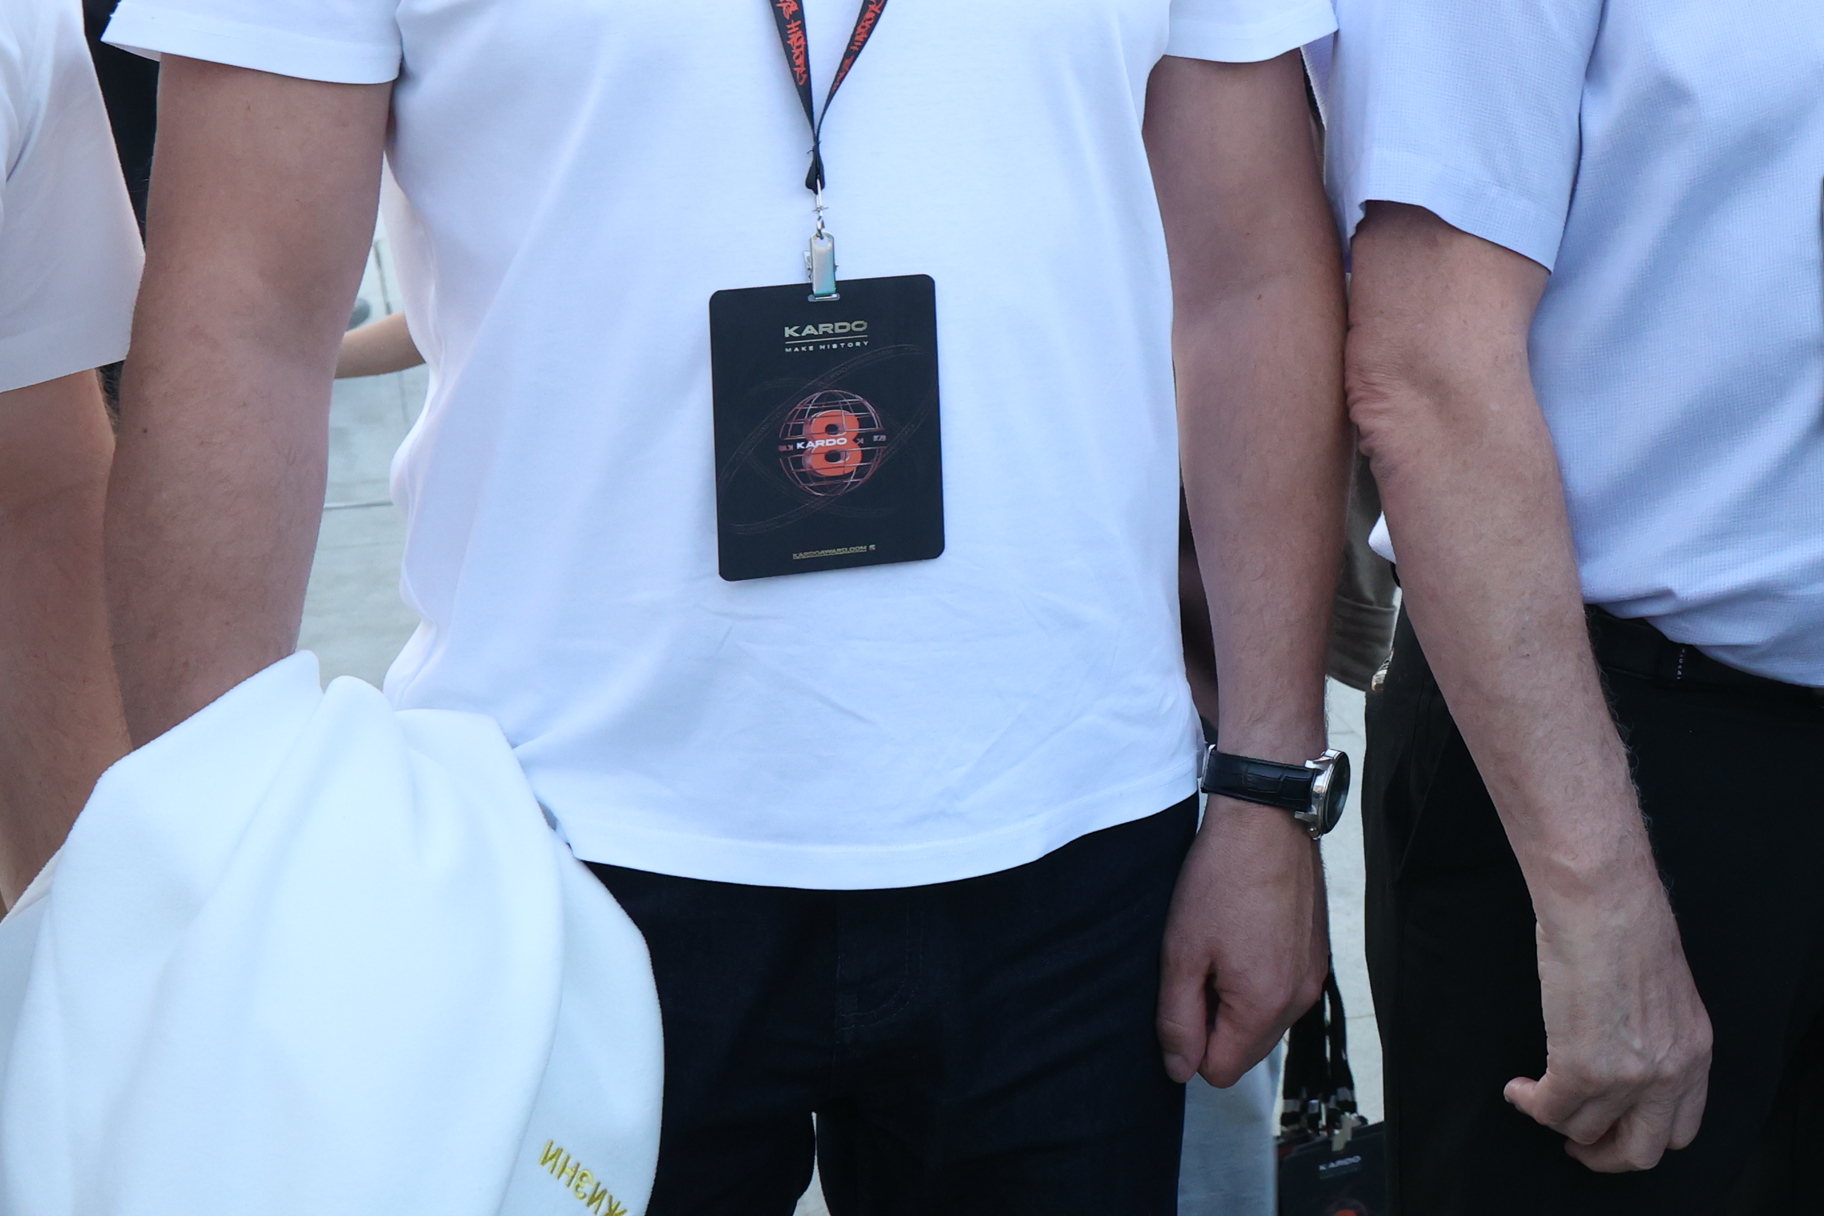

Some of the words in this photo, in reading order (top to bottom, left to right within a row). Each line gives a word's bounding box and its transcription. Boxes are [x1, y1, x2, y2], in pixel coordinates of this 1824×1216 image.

[784, 320, 868, 338] KARDO
[785, 345, 815, 353] MAKE
[819, 340, 870, 351] HISTORY
[796, 437, 848, 450] KARDO
[803, 410, 863, 477] 8
